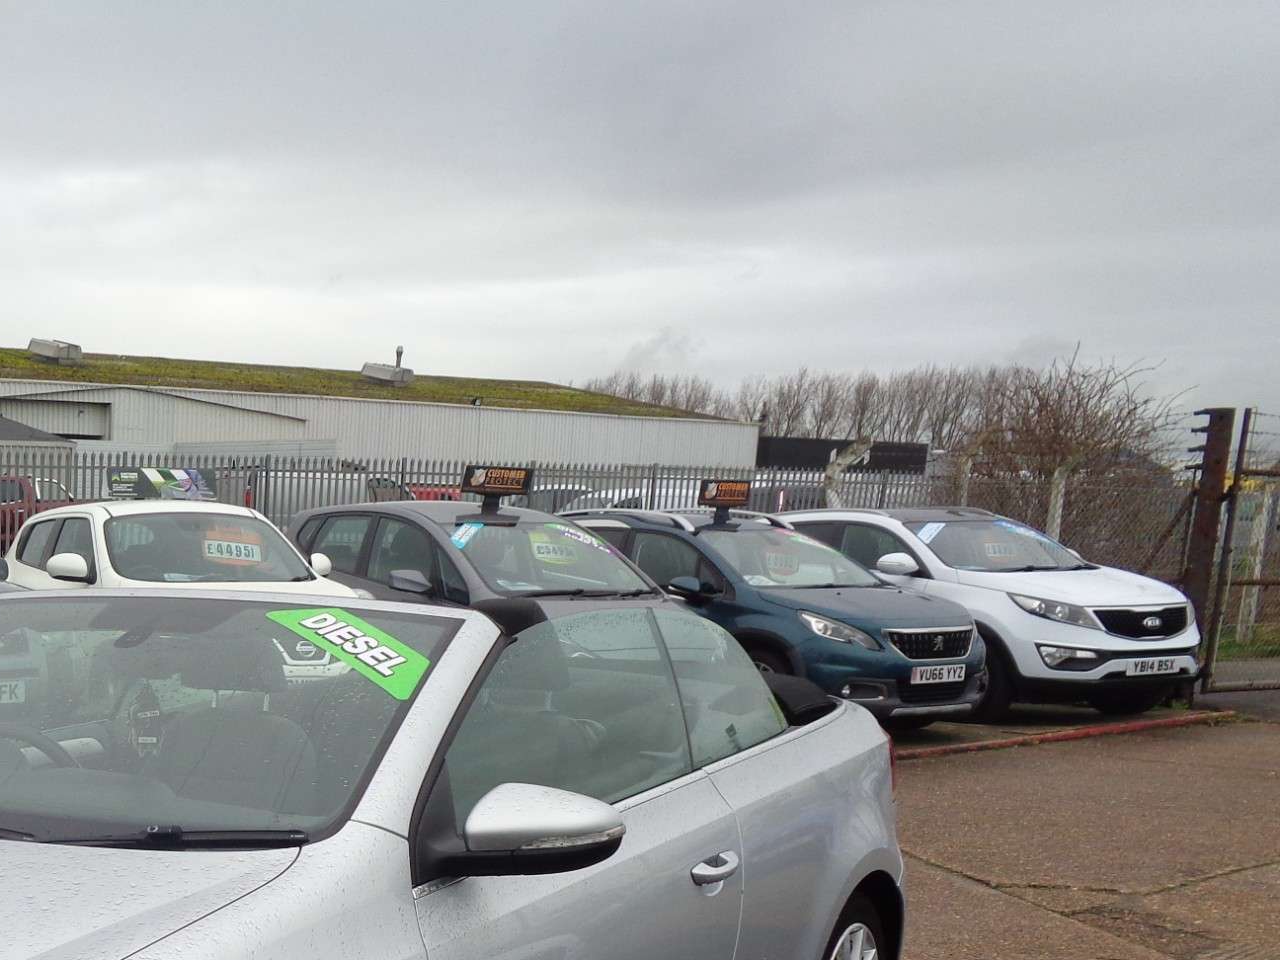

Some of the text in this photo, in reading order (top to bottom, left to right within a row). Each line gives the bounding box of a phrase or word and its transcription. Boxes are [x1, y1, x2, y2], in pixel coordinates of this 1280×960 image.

[487, 468, 527, 479] CUSTOMER
[299, 612, 408, 677] DIESEL
[947, 666, 964, 680] YYZ
